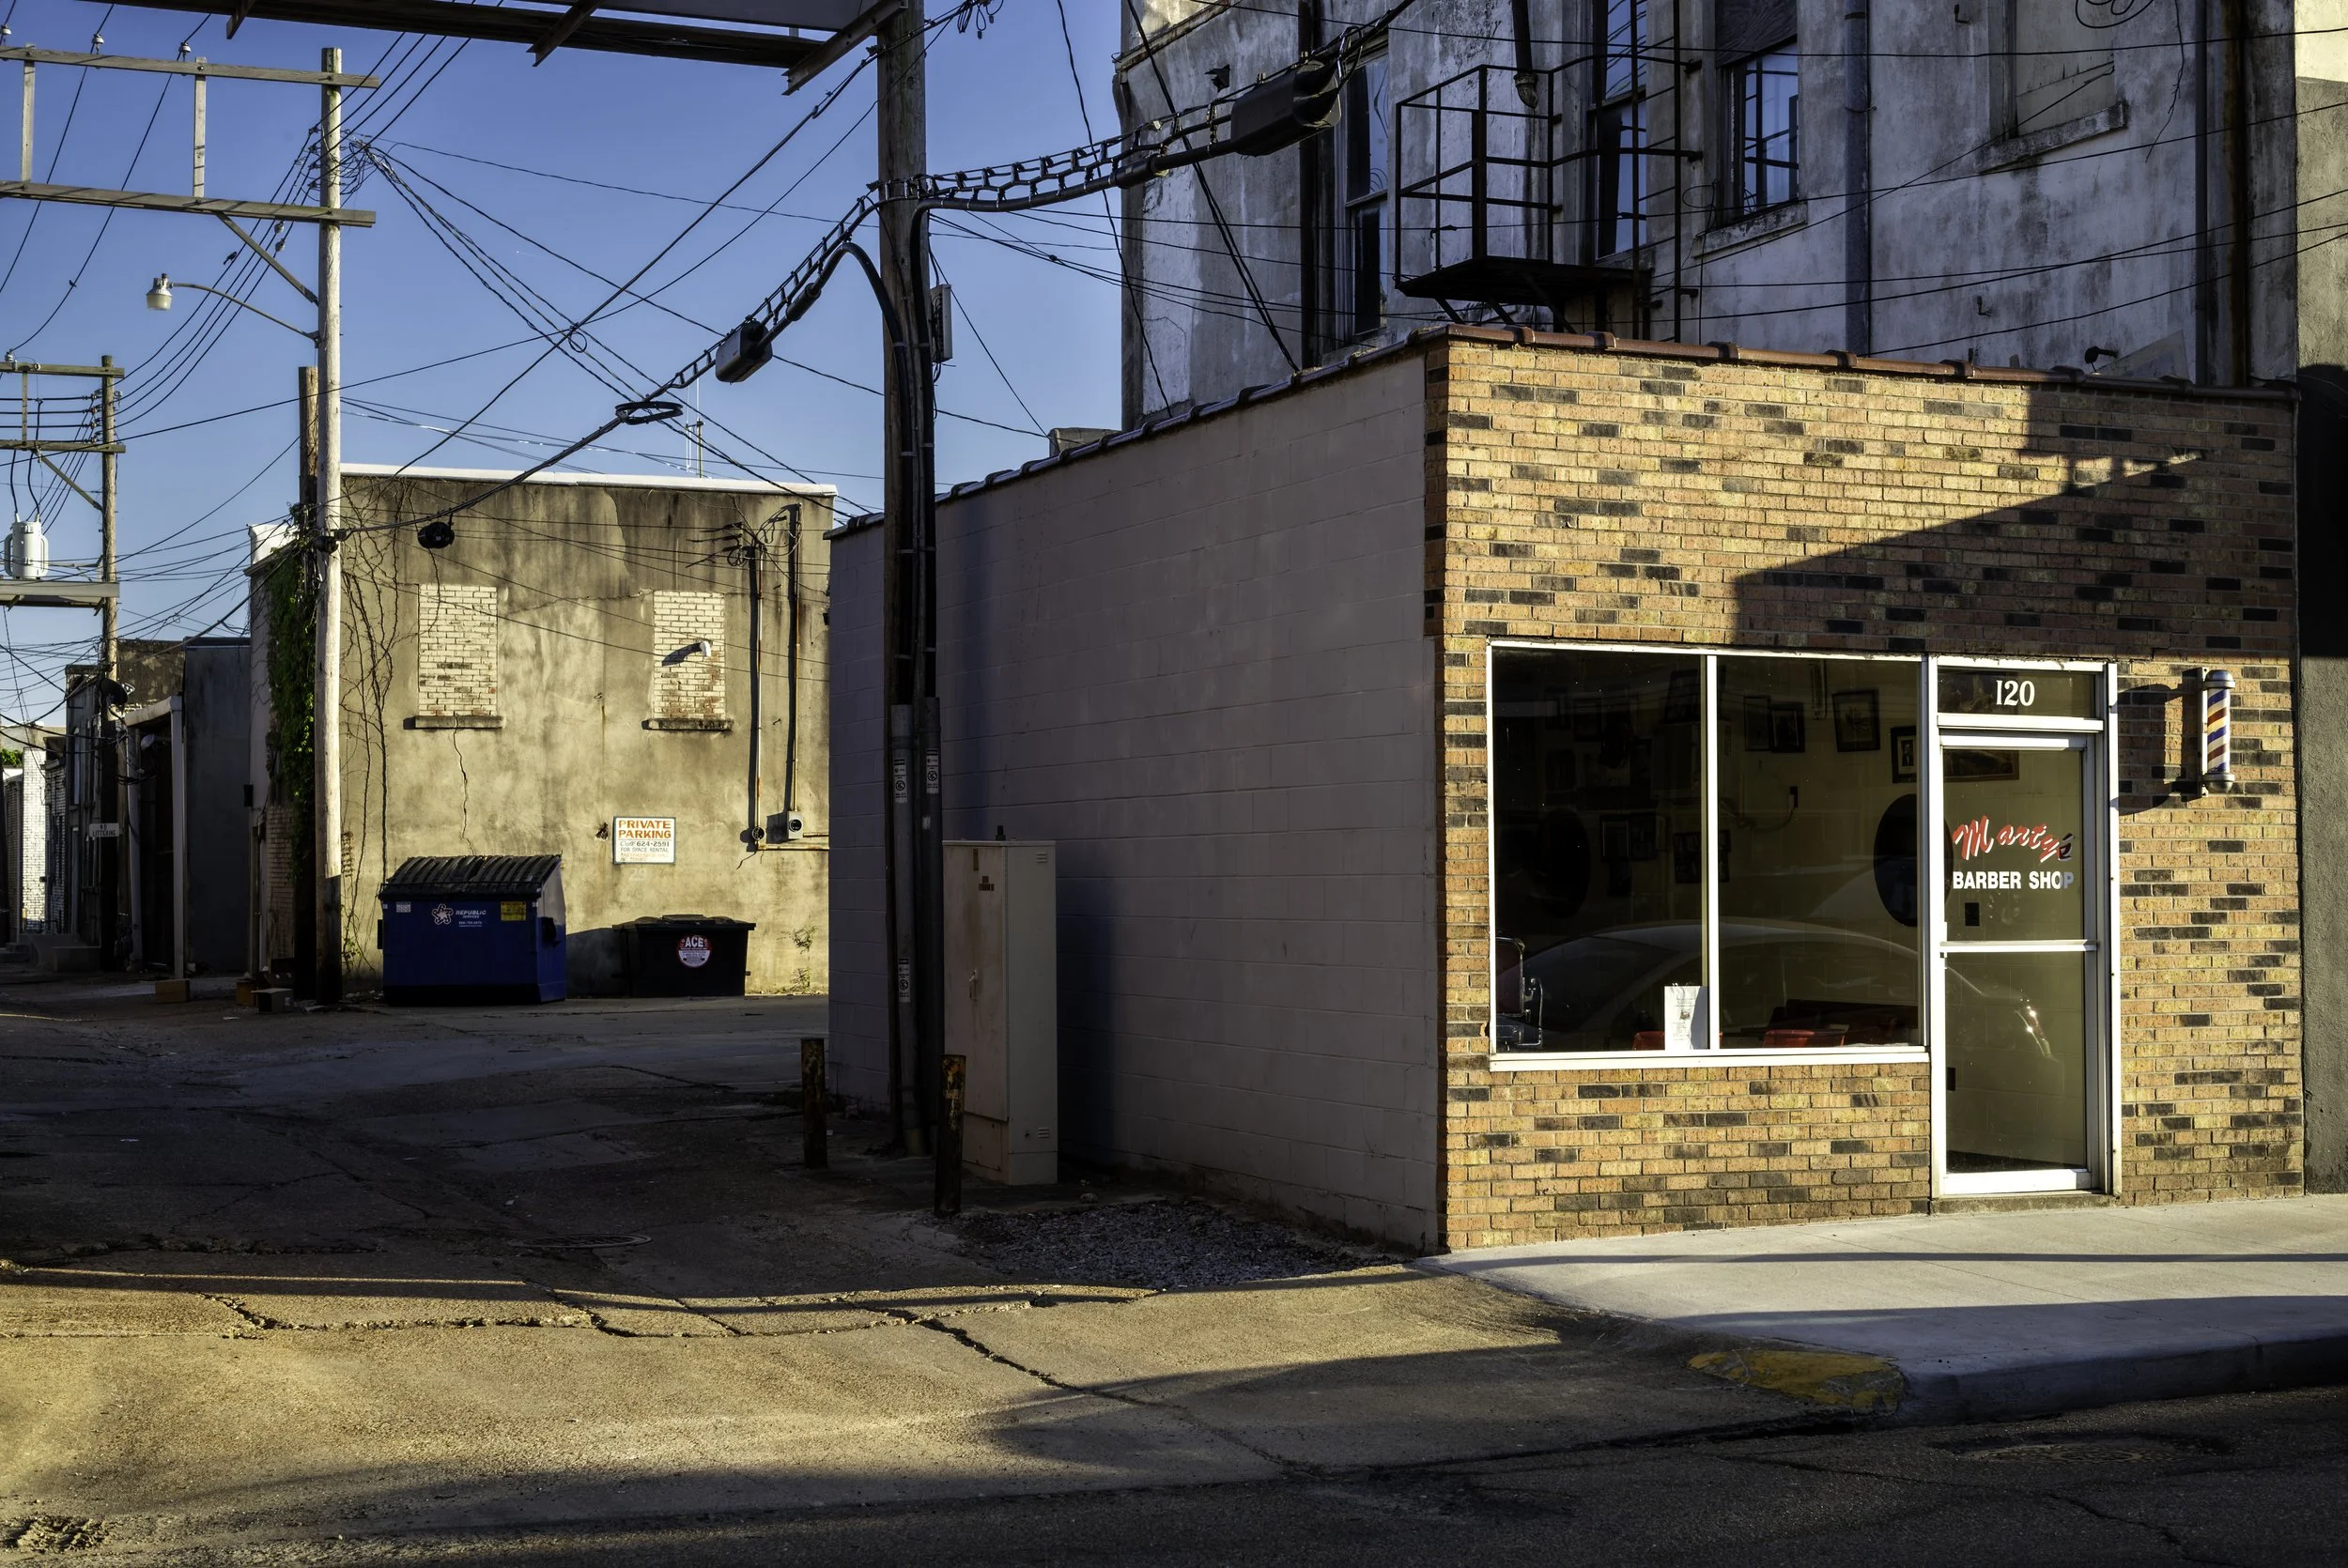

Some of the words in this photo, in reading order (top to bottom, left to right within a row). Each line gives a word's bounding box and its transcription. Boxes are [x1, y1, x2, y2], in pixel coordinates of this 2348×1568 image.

[1996, 680, 2035, 706] 120
[618, 820, 671, 829] PRIVATE
[618, 830, 671, 838] PARKING
[1953, 871, 2022, 889] BARBER
[2029, 870, 2075, 890] SHOP
[685, 936, 703, 947] ACE
